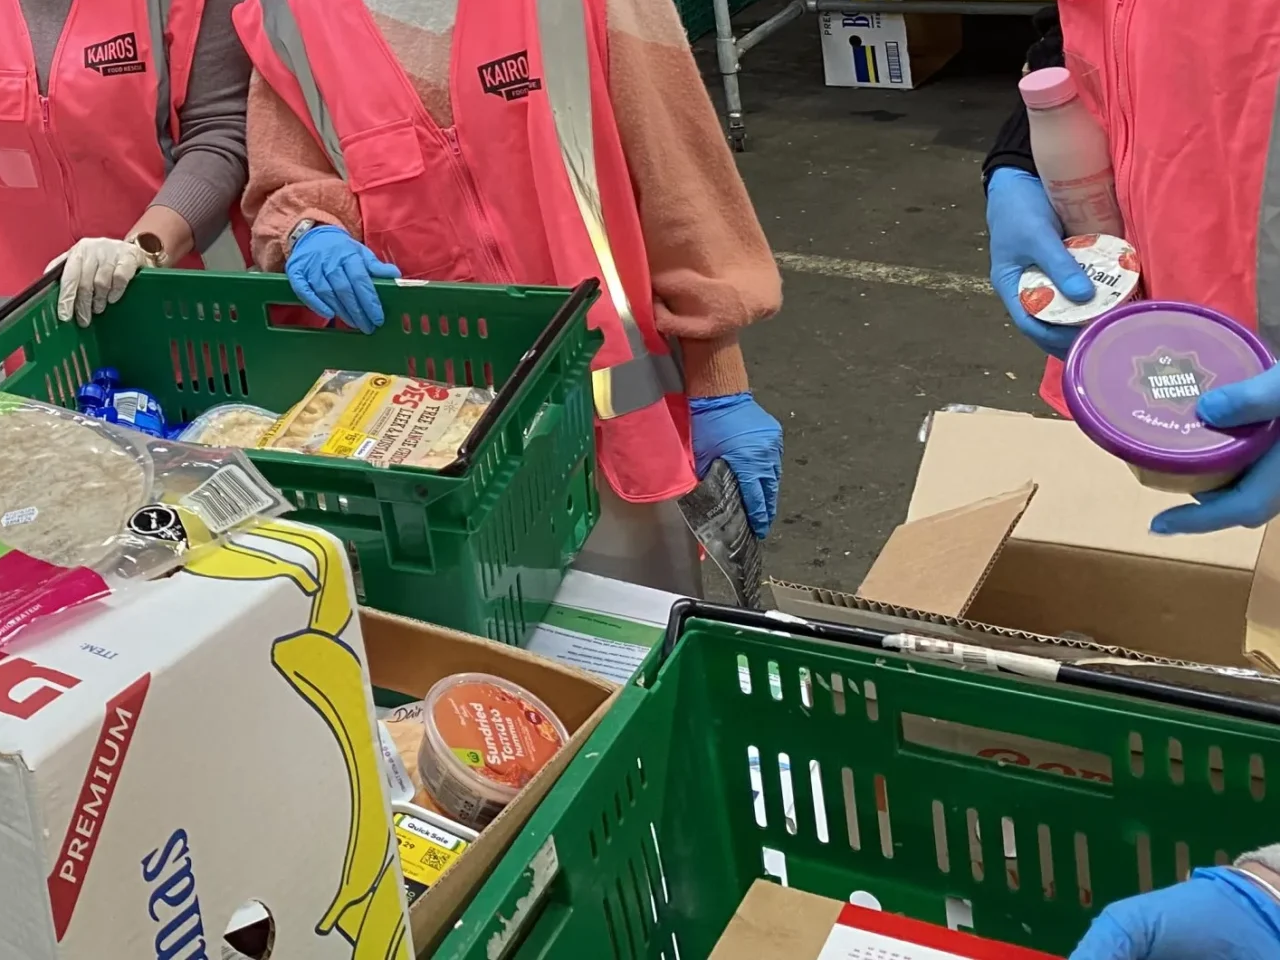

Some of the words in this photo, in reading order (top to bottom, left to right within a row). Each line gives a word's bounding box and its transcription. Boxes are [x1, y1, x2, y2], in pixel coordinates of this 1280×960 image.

[87, 37, 134, 63] KAIROS
[1148, 373, 1195, 387] TURKISH
[1151, 385, 1200, 400] KITCHEN
[391, 408, 413, 429] LEEK
[418, 404, 440, 428] FREE
[1131, 409, 1180, 431] Celebrate
[401, 424, 426, 451] RANGE
[80, 642, 119, 660] ITEM:
[469, 702, 501, 765] Sundried
[491, 708, 516, 762] Tomato
[505, 716, 526, 757] hummus
[59, 706, 133, 884] PREMIUM
[407, 821, 430, 837] Quick
[430, 832, 449, 846] Sale
